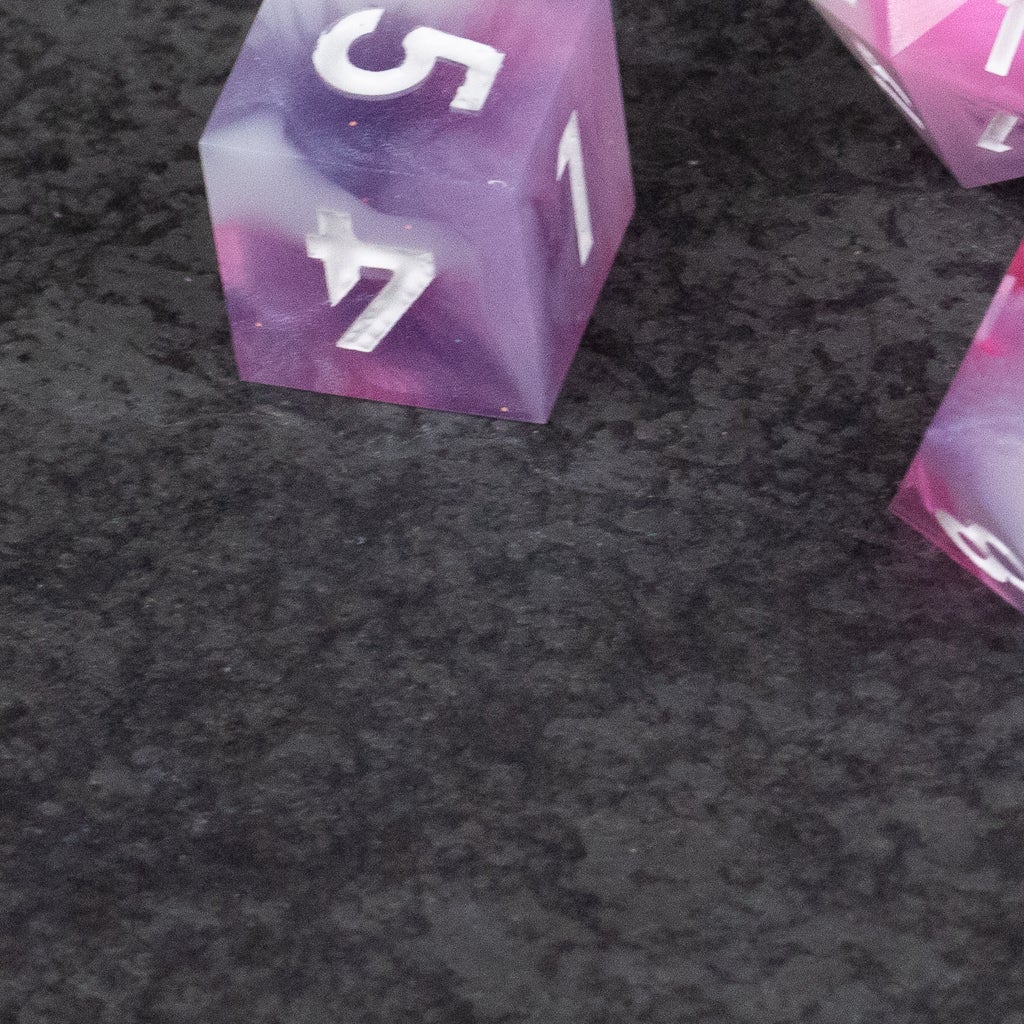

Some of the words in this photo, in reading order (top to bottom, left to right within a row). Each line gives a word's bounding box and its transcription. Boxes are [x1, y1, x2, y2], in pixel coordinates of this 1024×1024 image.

[311, 8, 506, 112] 5
[555, 109, 594, 267] 1
[305, 208, 436, 353] 4
